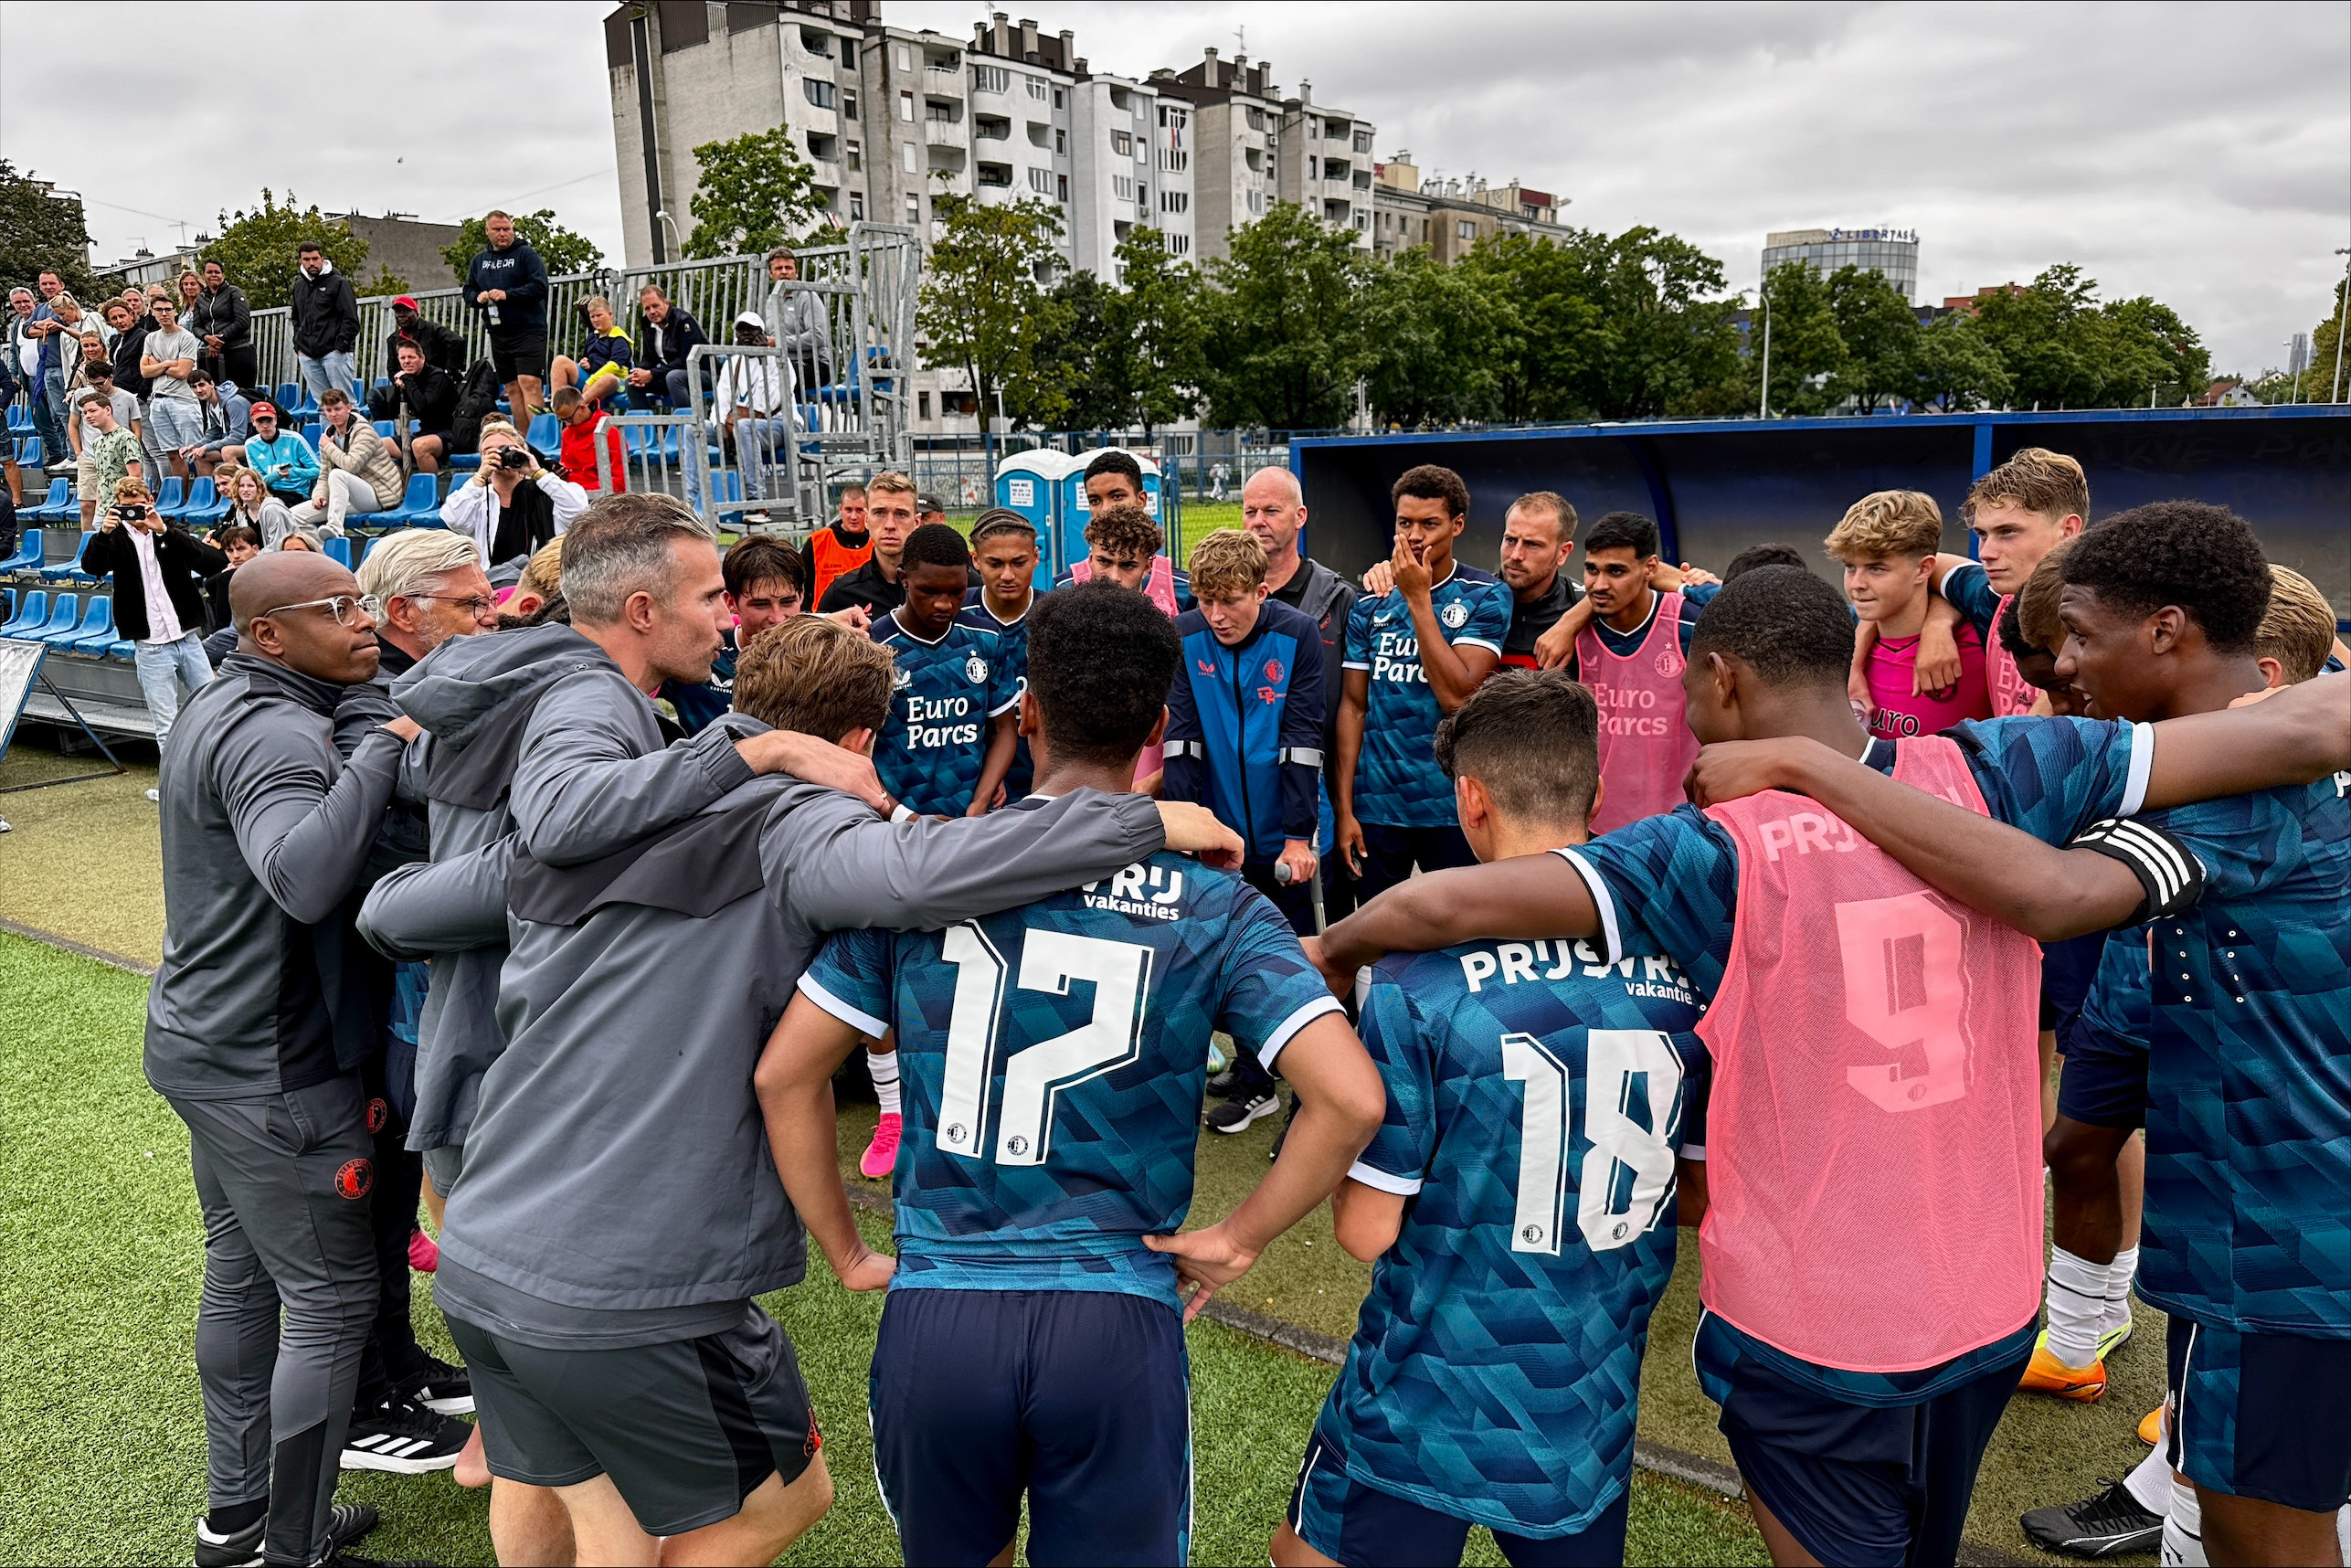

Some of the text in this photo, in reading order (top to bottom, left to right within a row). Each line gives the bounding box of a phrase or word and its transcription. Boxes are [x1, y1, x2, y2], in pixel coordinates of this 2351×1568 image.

[1847, 229, 1908, 241] LIBERTAS
[1377, 632, 1419, 656] Eur
[1372, 656, 1428, 683] Parc
[907, 695, 969, 723] Euro
[1594, 683, 1656, 709] Euro
[1597, 710, 1668, 736] Parcs
[1871, 705, 1920, 736] uro
[907, 724, 978, 750] Parcs
[1084, 892, 1180, 921] vakanties
[1625, 980, 1693, 1005] vakantie
[1835, 890, 1975, 1115] 9
[936, 917, 1155, 1166] 17
[1500, 1029, 1686, 1256] 18
